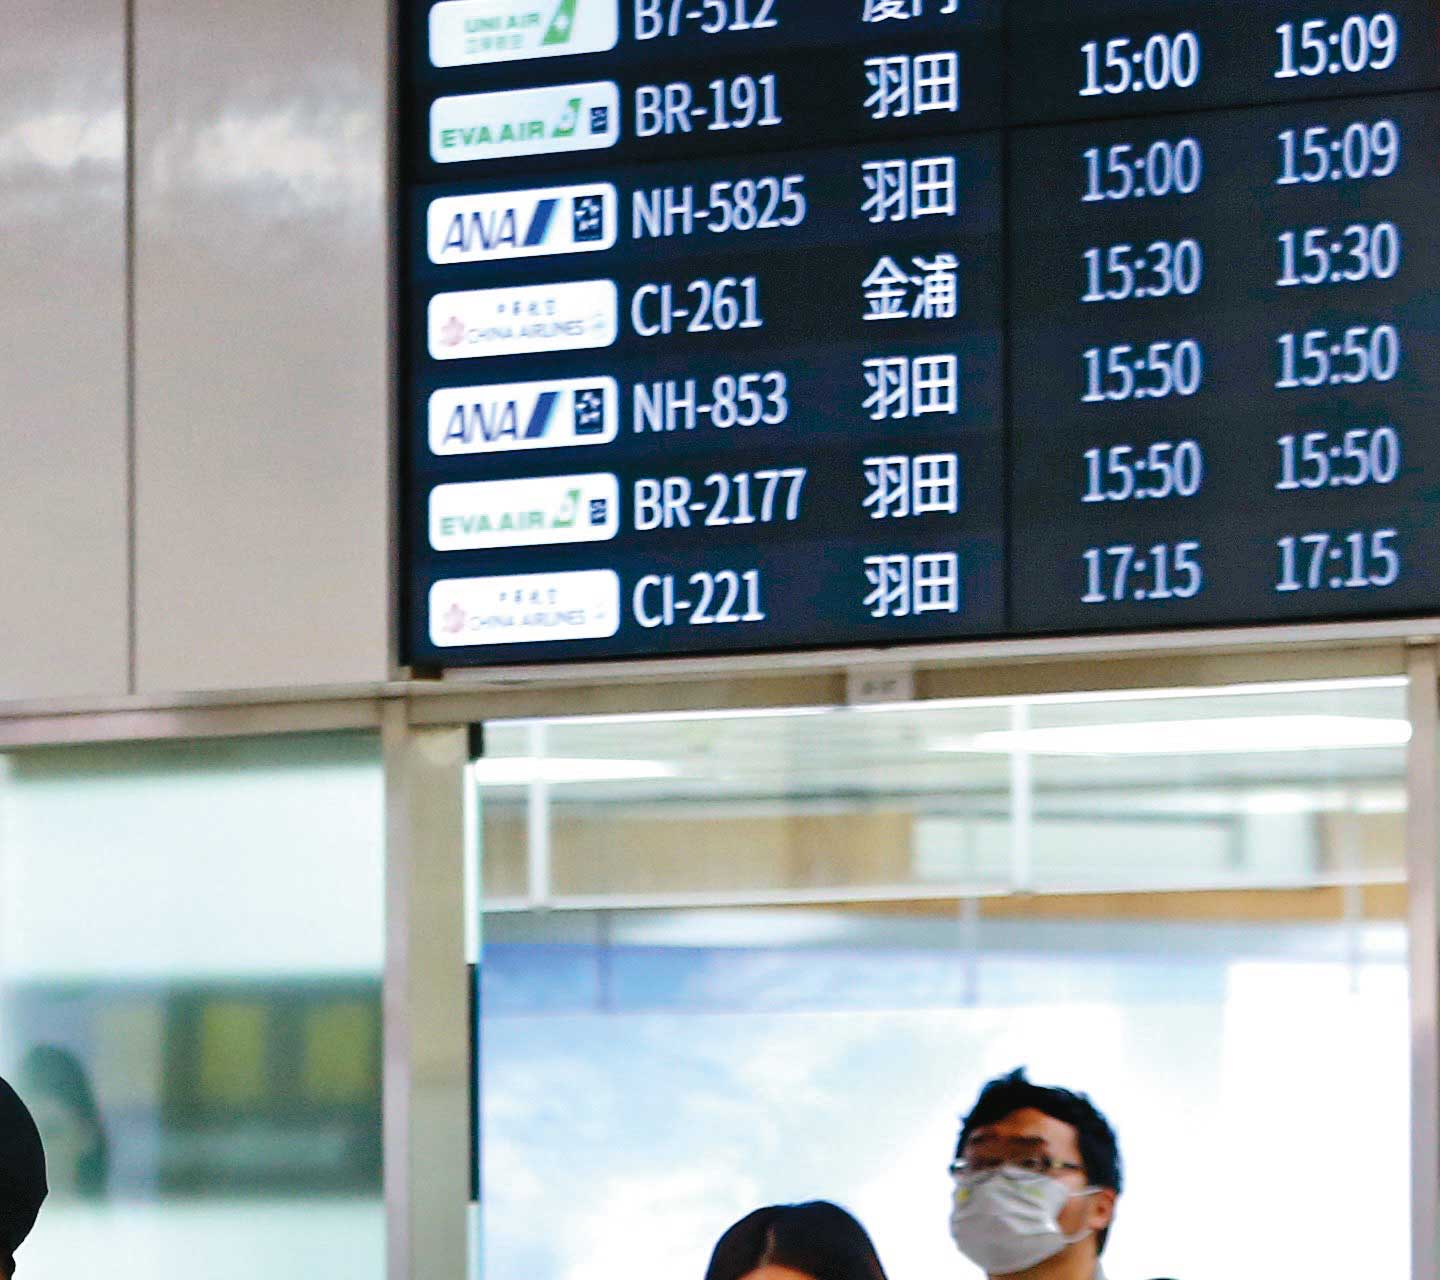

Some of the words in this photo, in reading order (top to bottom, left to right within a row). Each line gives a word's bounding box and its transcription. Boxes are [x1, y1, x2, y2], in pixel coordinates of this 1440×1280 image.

[636, 75, 783, 138] BR-191
[864, 51, 961, 121] 羽田
[1079, 32, 1202, 98] 15:00
[1275, 13, 1400, 80] 15:09
[440, 124, 492, 149] EVA
[499, 119, 545, 143] AIR
[633, 175, 808, 240] NH-5825
[861, 156, 958, 225] 羽田
[1082, 138, 1204, 203] 15:00
[1277, 121, 1401, 186] 15:09
[441, 208, 517, 254] ANA
[631, 277, 765, 338] CI-261
[862, 254, 961, 322] 金浦
[1082, 239, 1203, 303] 15:30
[1277, 223, 1402, 288] 15:30
[442, 400, 517, 445] ANA
[634, 371, 790, 434] NH-853
[862, 354, 960, 422] 羽田
[1082, 341, 1203, 404] 15:50
[1276, 325, 1401, 389] 15:50
[440, 514, 492, 537] EVA
[498, 510, 545, 530] AIR
[634, 468, 808, 532] BR-2177
[863, 453, 960, 520] 羽田
[1082, 441, 1204, 504] 15:50
[1276, 428, 1401, 491] 15:50
[633, 569, 767, 629] CI-221
[863, 552, 960, 619] 羽田
[1082, 542, 1203, 604] 17:15
[1276, 528, 1401, 593] 17:15
